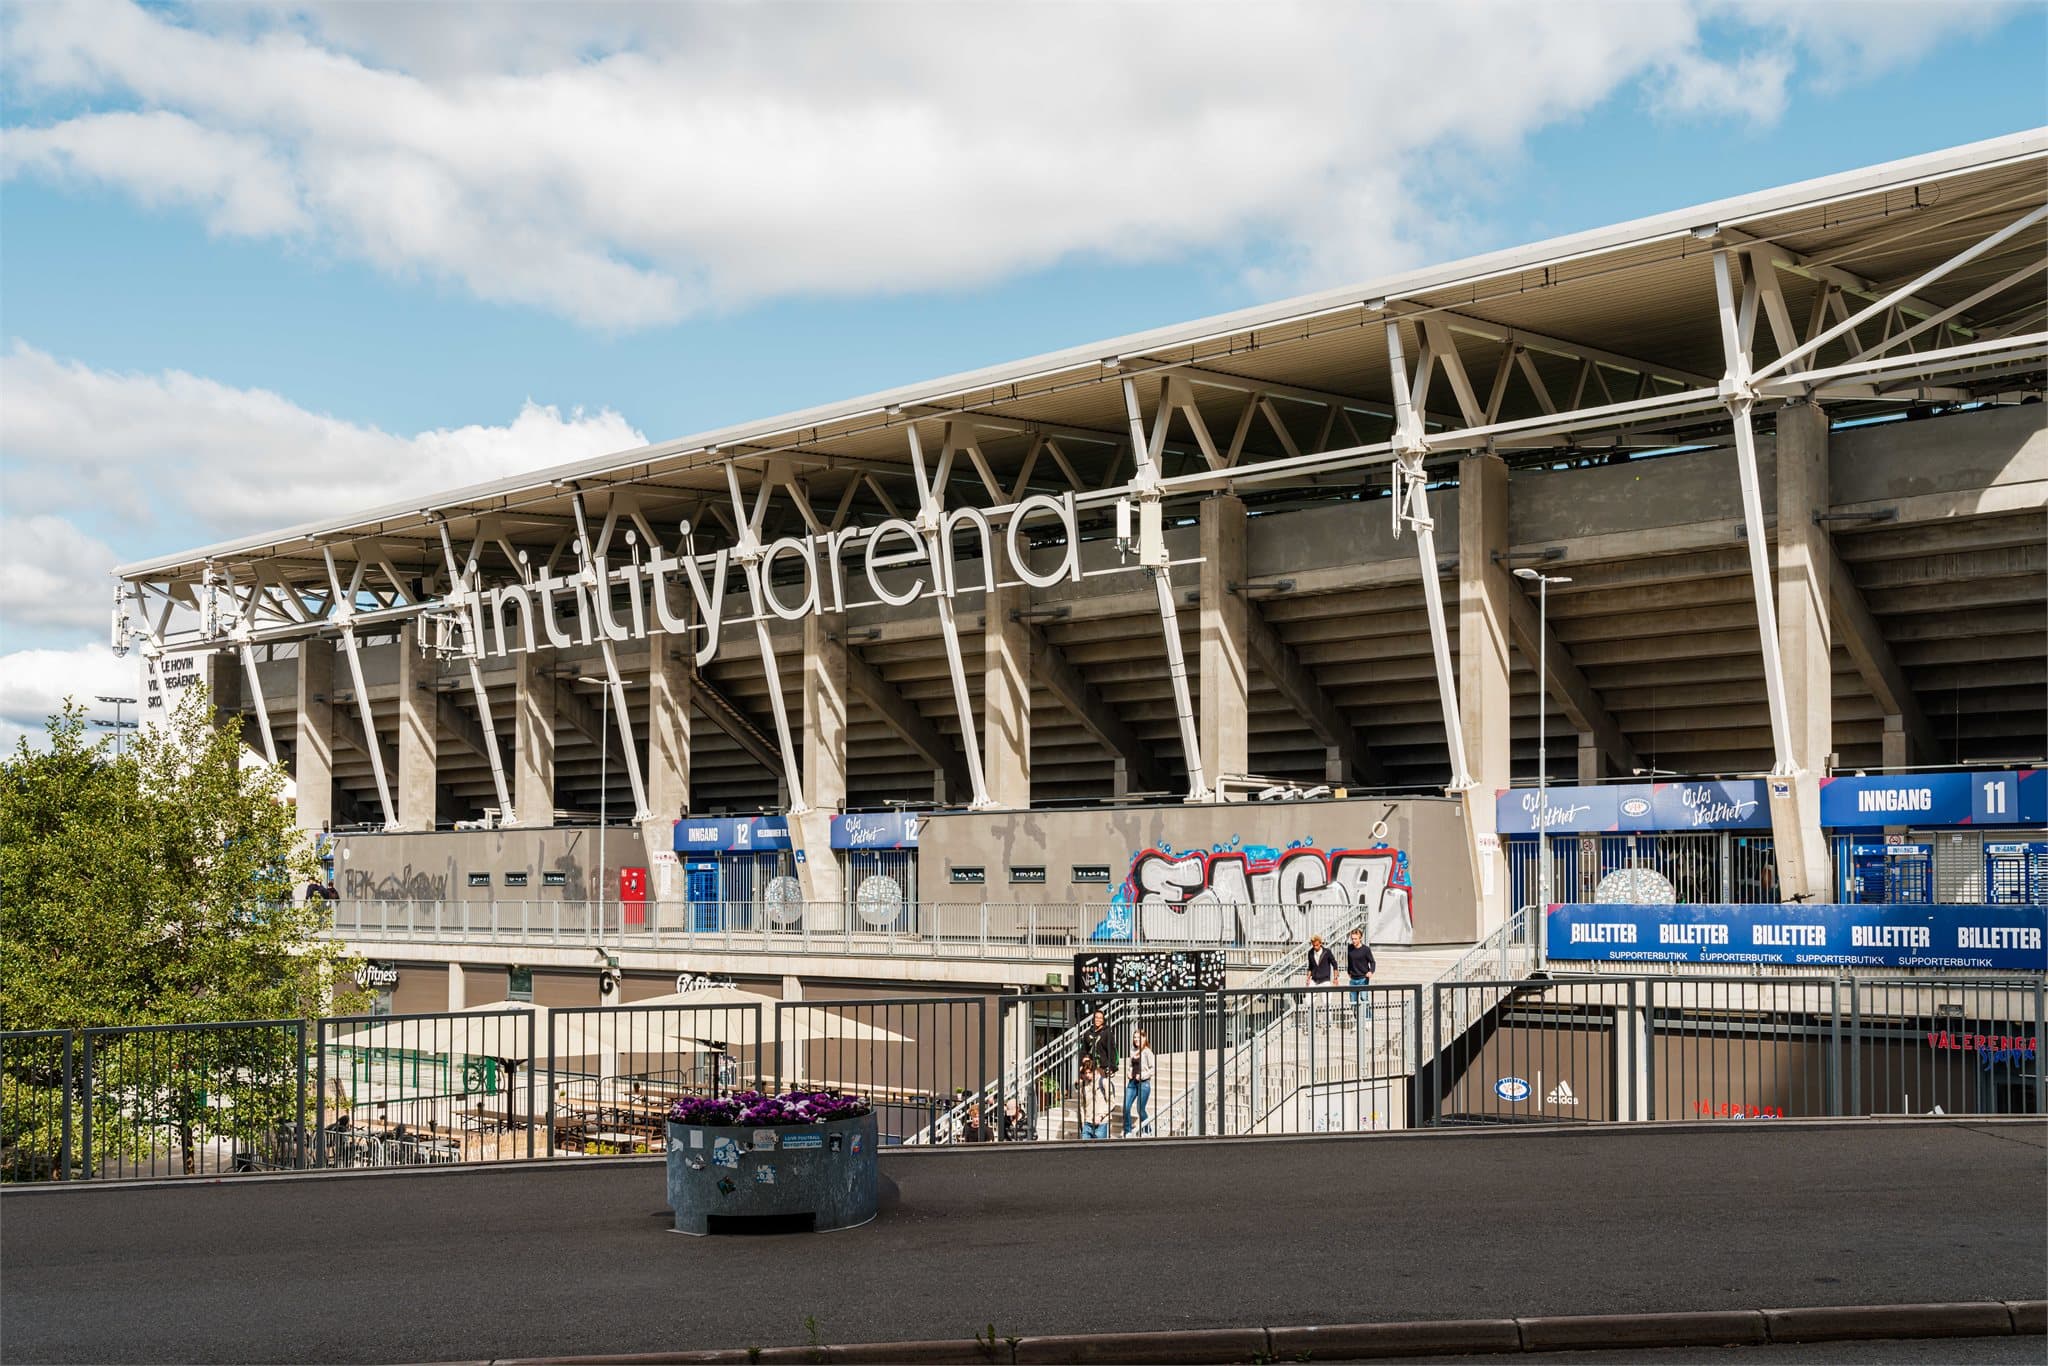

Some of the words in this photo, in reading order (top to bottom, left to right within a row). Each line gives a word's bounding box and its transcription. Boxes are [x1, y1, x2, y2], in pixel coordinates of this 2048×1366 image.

[463, 519, 729, 667] intility
[762, 491, 1082, 622] arena
[148, 661, 170, 674] VLE
[171, 657, 193, 671] HOVIN
[1682, 785, 1712, 808] Oslos
[1858, 788, 1932, 812] INNGANG
[1983, 781, 2006, 814] 11
[1692, 800, 1759, 827] stolthet
[688, 827, 718, 842] INNGANG
[736, 823, 749, 844] 12
[904, 818, 918, 841] 12
[1570, 923, 1637, 944] BILLETTER
[1659, 924, 1729, 945] BILLETTER
[1752, 925, 1826, 946] BILLETTER
[1851, 926, 1931, 947] BILLETTER
[1957, 927, 2042, 949] BILLETTER
[1609, 951, 1688, 960] SUPPORTERBUTIKK
[1699, 953, 1783, 962] SUPPORTERBUTIKK
[1795, 954, 1885, 964] SUPPORTERBUTIKK
[1898, 957, 1993, 967] SUPPORTERBUTIKK
[367, 965, 397, 985] fitness
[1927, 1030, 2037, 1051] VÅLERENGA
